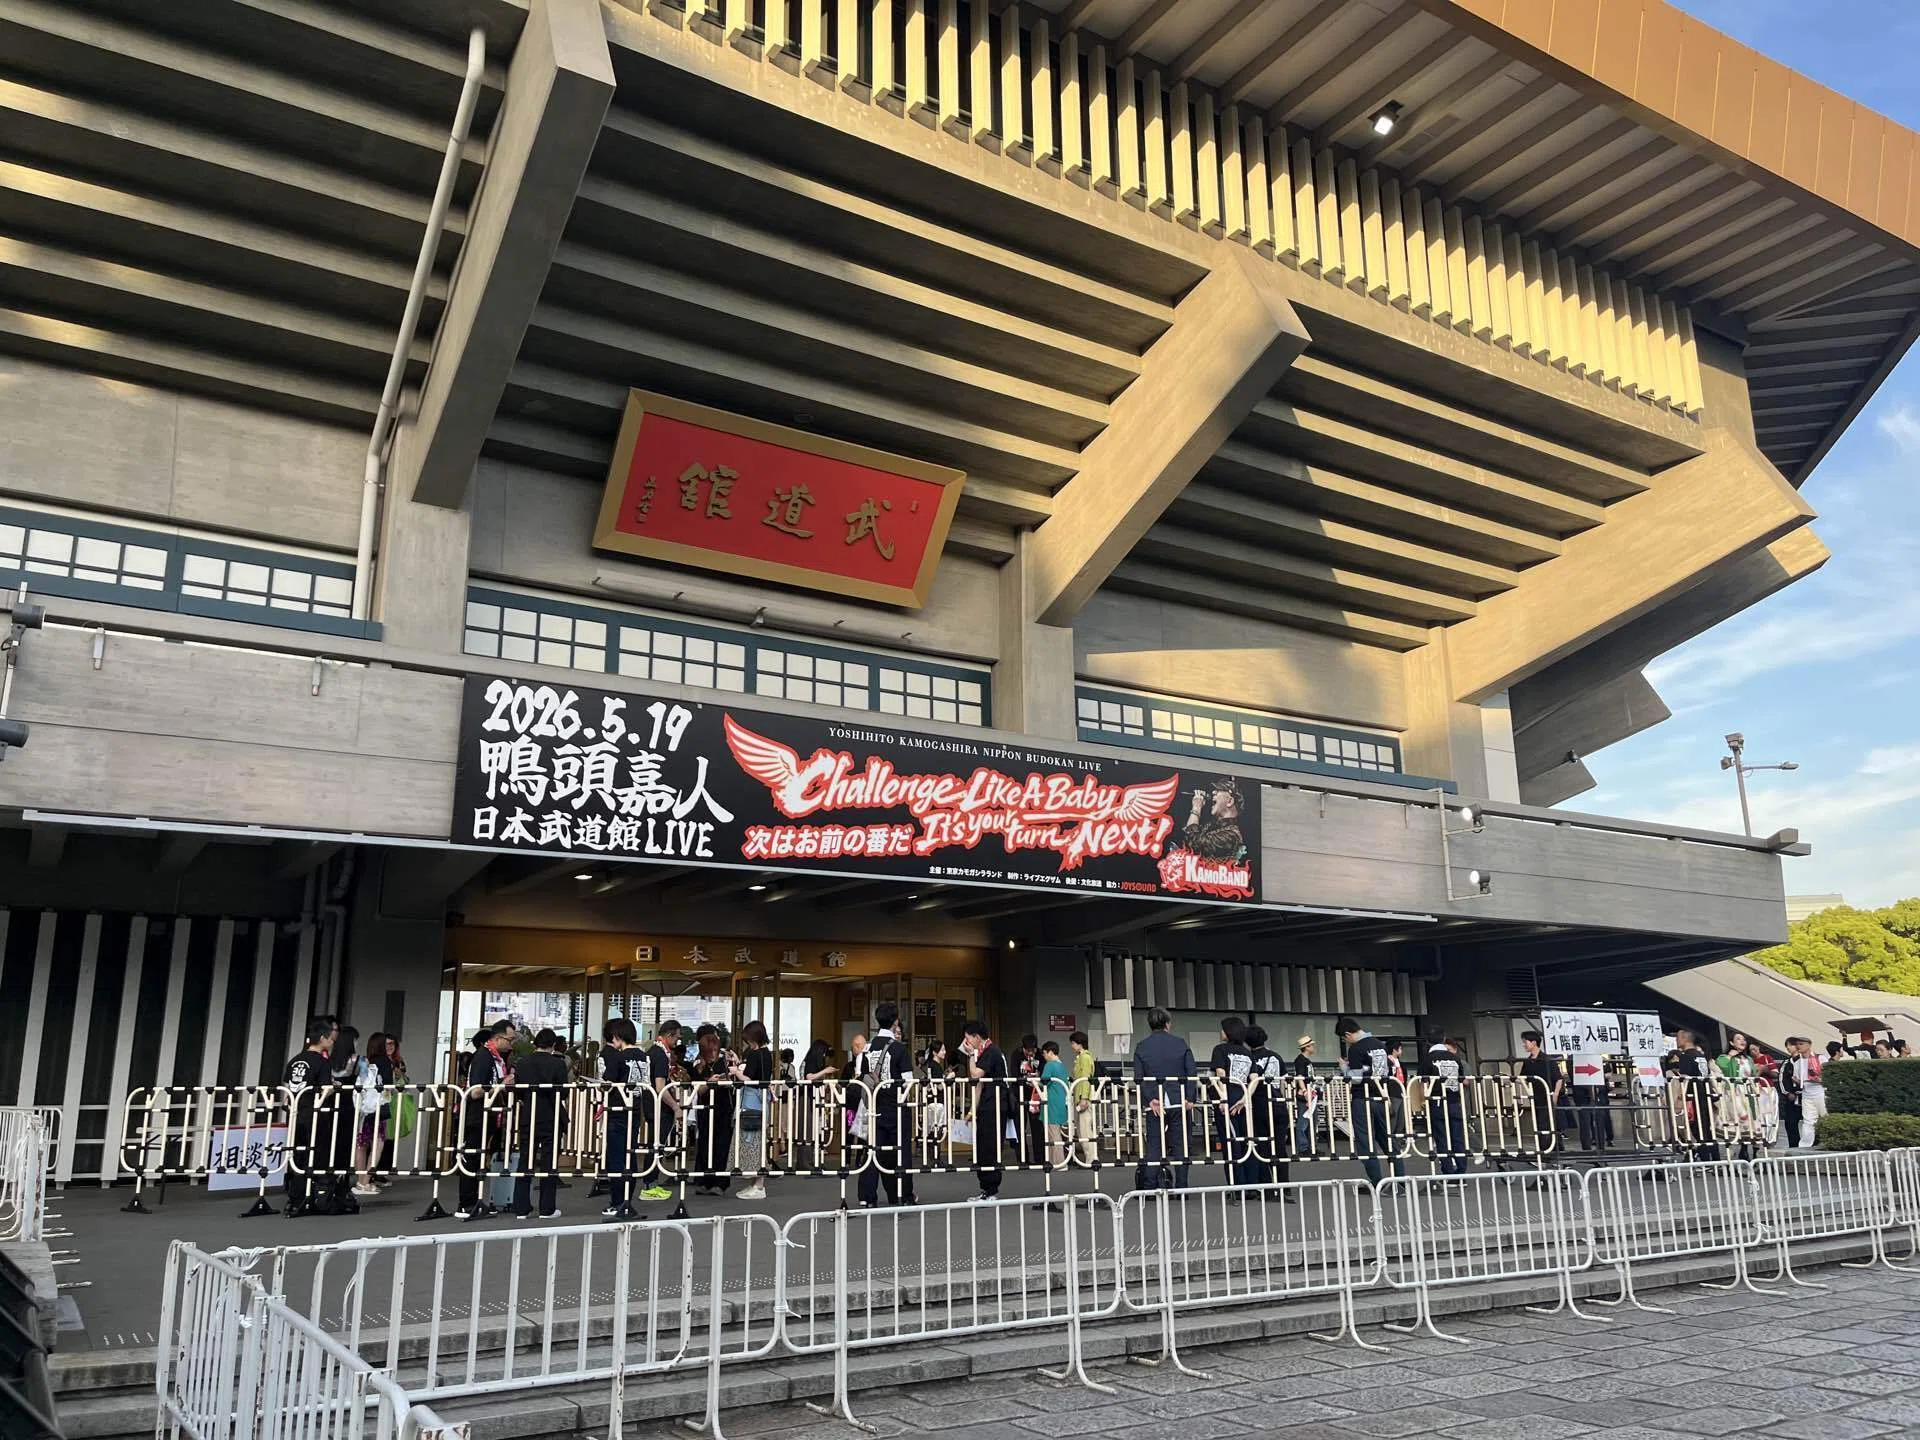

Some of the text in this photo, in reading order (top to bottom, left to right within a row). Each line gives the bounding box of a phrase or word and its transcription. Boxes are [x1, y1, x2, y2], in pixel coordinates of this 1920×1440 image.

[482, 679, 693, 751] 2026.5.19
[829, 727, 1102, 772] YOSHIHITO KAMOGASHIRA NIPPON BUDOKAN LIVE
[479, 734, 734, 823] 鴨頭嘉人
[783, 754, 964, 816] Challenge
[1043, 775, 1117, 817] Baby
[746, 826, 912, 856] 次はお前の番だ
[1068, 817, 1166, 867] Next!
[636, 945, 848, 968] 日本武道館
[1544, 1015, 1580, 1029] アリーナ
[1586, 1025, 1619, 1043] 入場口
[1628, 1022, 1660, 1034] スポンサー
[1550, 1035, 1582, 1051] 1階席
[1638, 1038, 1655, 1049] 受付
